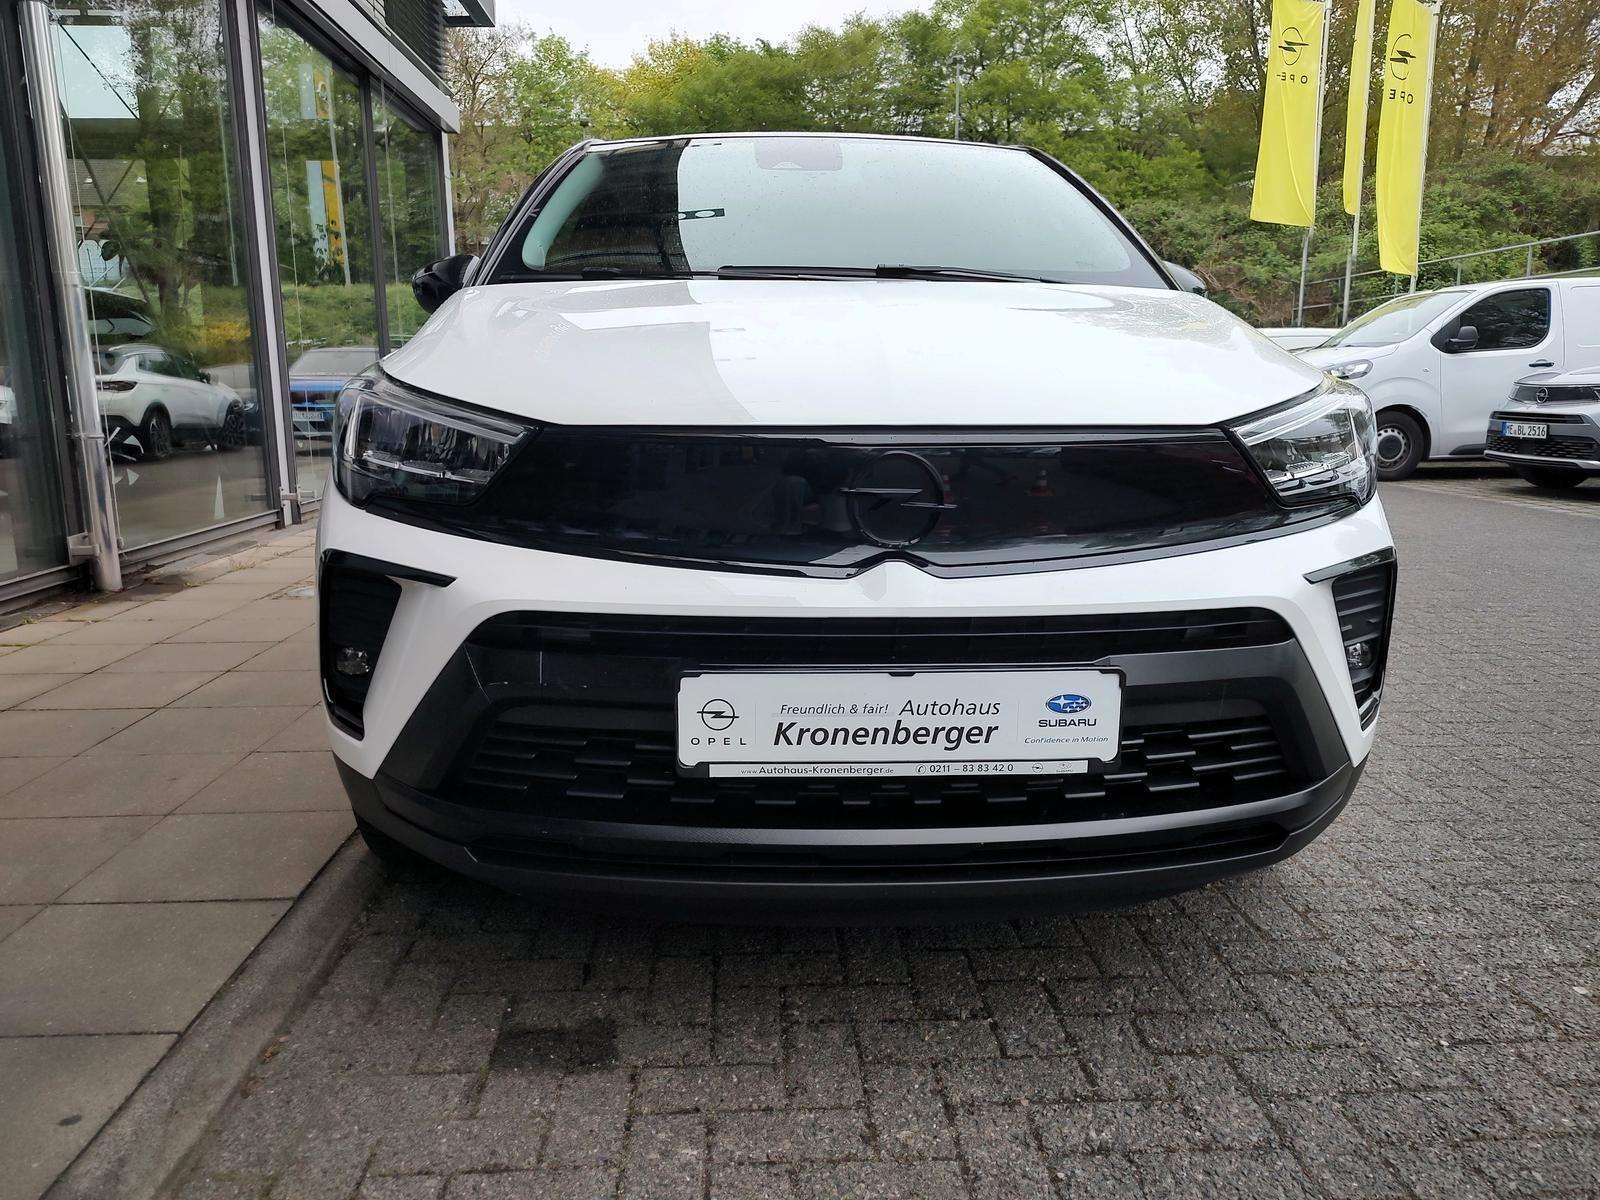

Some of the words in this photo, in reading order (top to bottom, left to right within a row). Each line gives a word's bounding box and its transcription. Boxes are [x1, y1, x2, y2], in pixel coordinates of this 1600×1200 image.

[1517, 425, 1526, 436] BL
[1527, 425, 1546, 437] 2516
[780, 704, 845, 715] Freundlich
[849, 703, 858, 714] &
[862, 703, 889, 714] fair!
[898, 698, 1001, 716] Autohaus
[1038, 718, 1097, 728] SUBARU
[773, 719, 999, 752] Kronenberger
[1024, 735, 1070, 744] Confidence
[1071, 735, 1080, 743] in
[1080, 734, 1109, 743] Motion
[690, 737, 747, 746] OPEL
[740, 765, 894, 776] www.Autohaus-Kronenberger.de
[929, 764, 950, 774] 0211
[962, 763, 974, 773] 83
[977, 763, 989, 773] 83
[992, 763, 1005, 773] 42
[1007, 763, 1014, 772] 0
